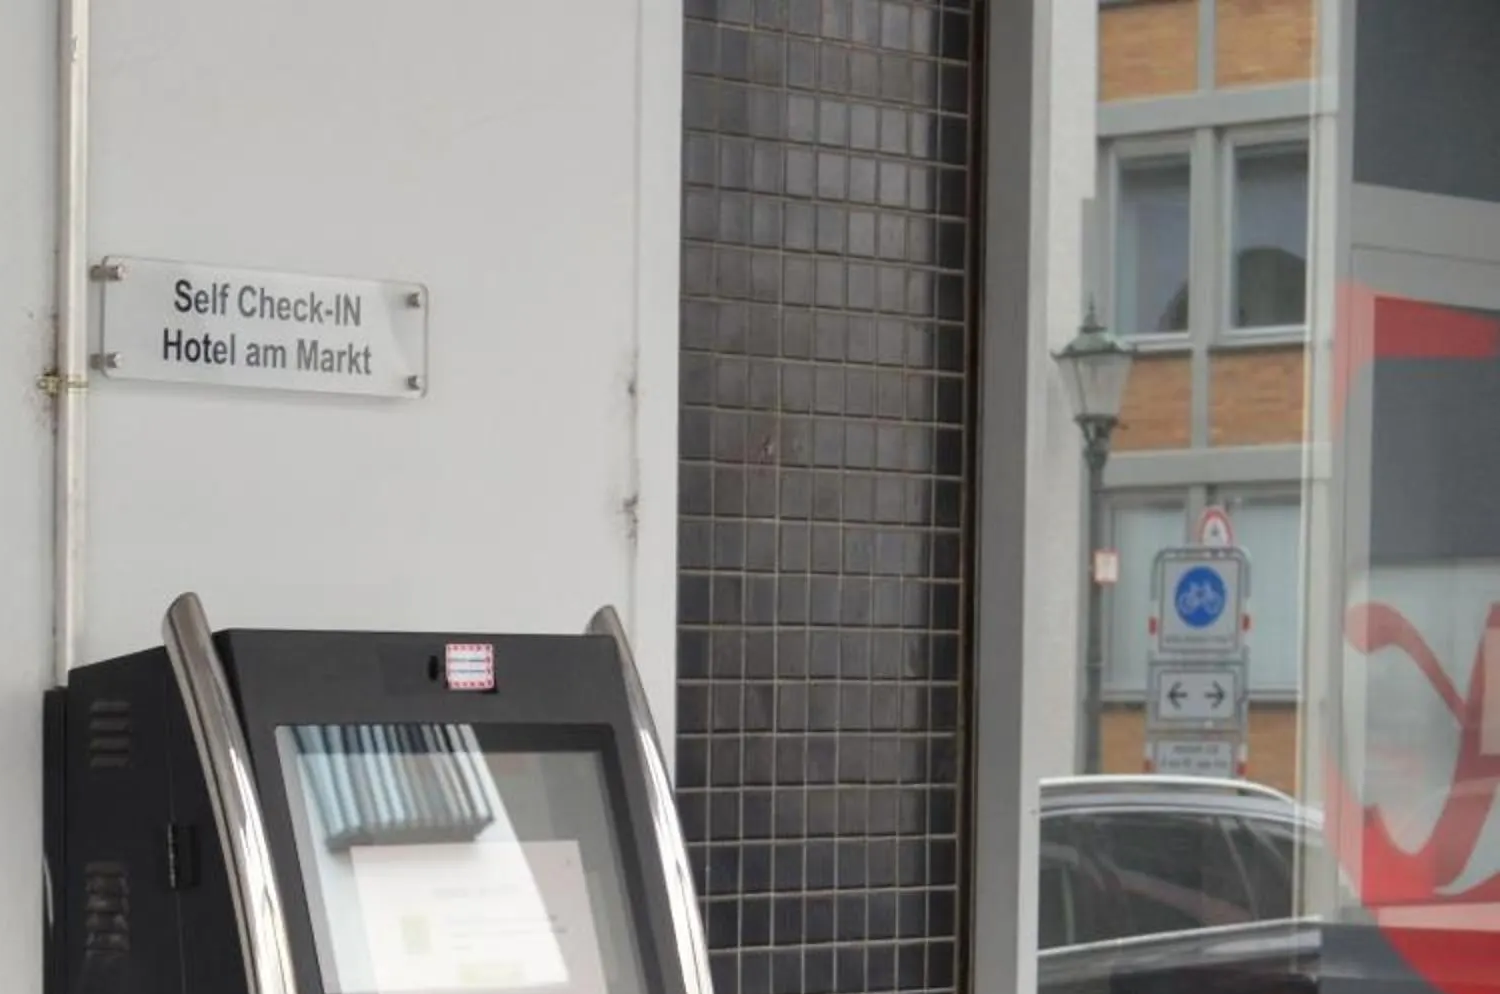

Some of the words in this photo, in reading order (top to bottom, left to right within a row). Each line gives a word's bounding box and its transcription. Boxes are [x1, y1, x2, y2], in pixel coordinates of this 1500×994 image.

[175, 280, 230, 314] Self
[238, 285, 361, 326] Check-IN
[163, 328, 235, 365] Hotel
[246, 344, 286, 369] am
[297, 338, 372, 375] Markt
